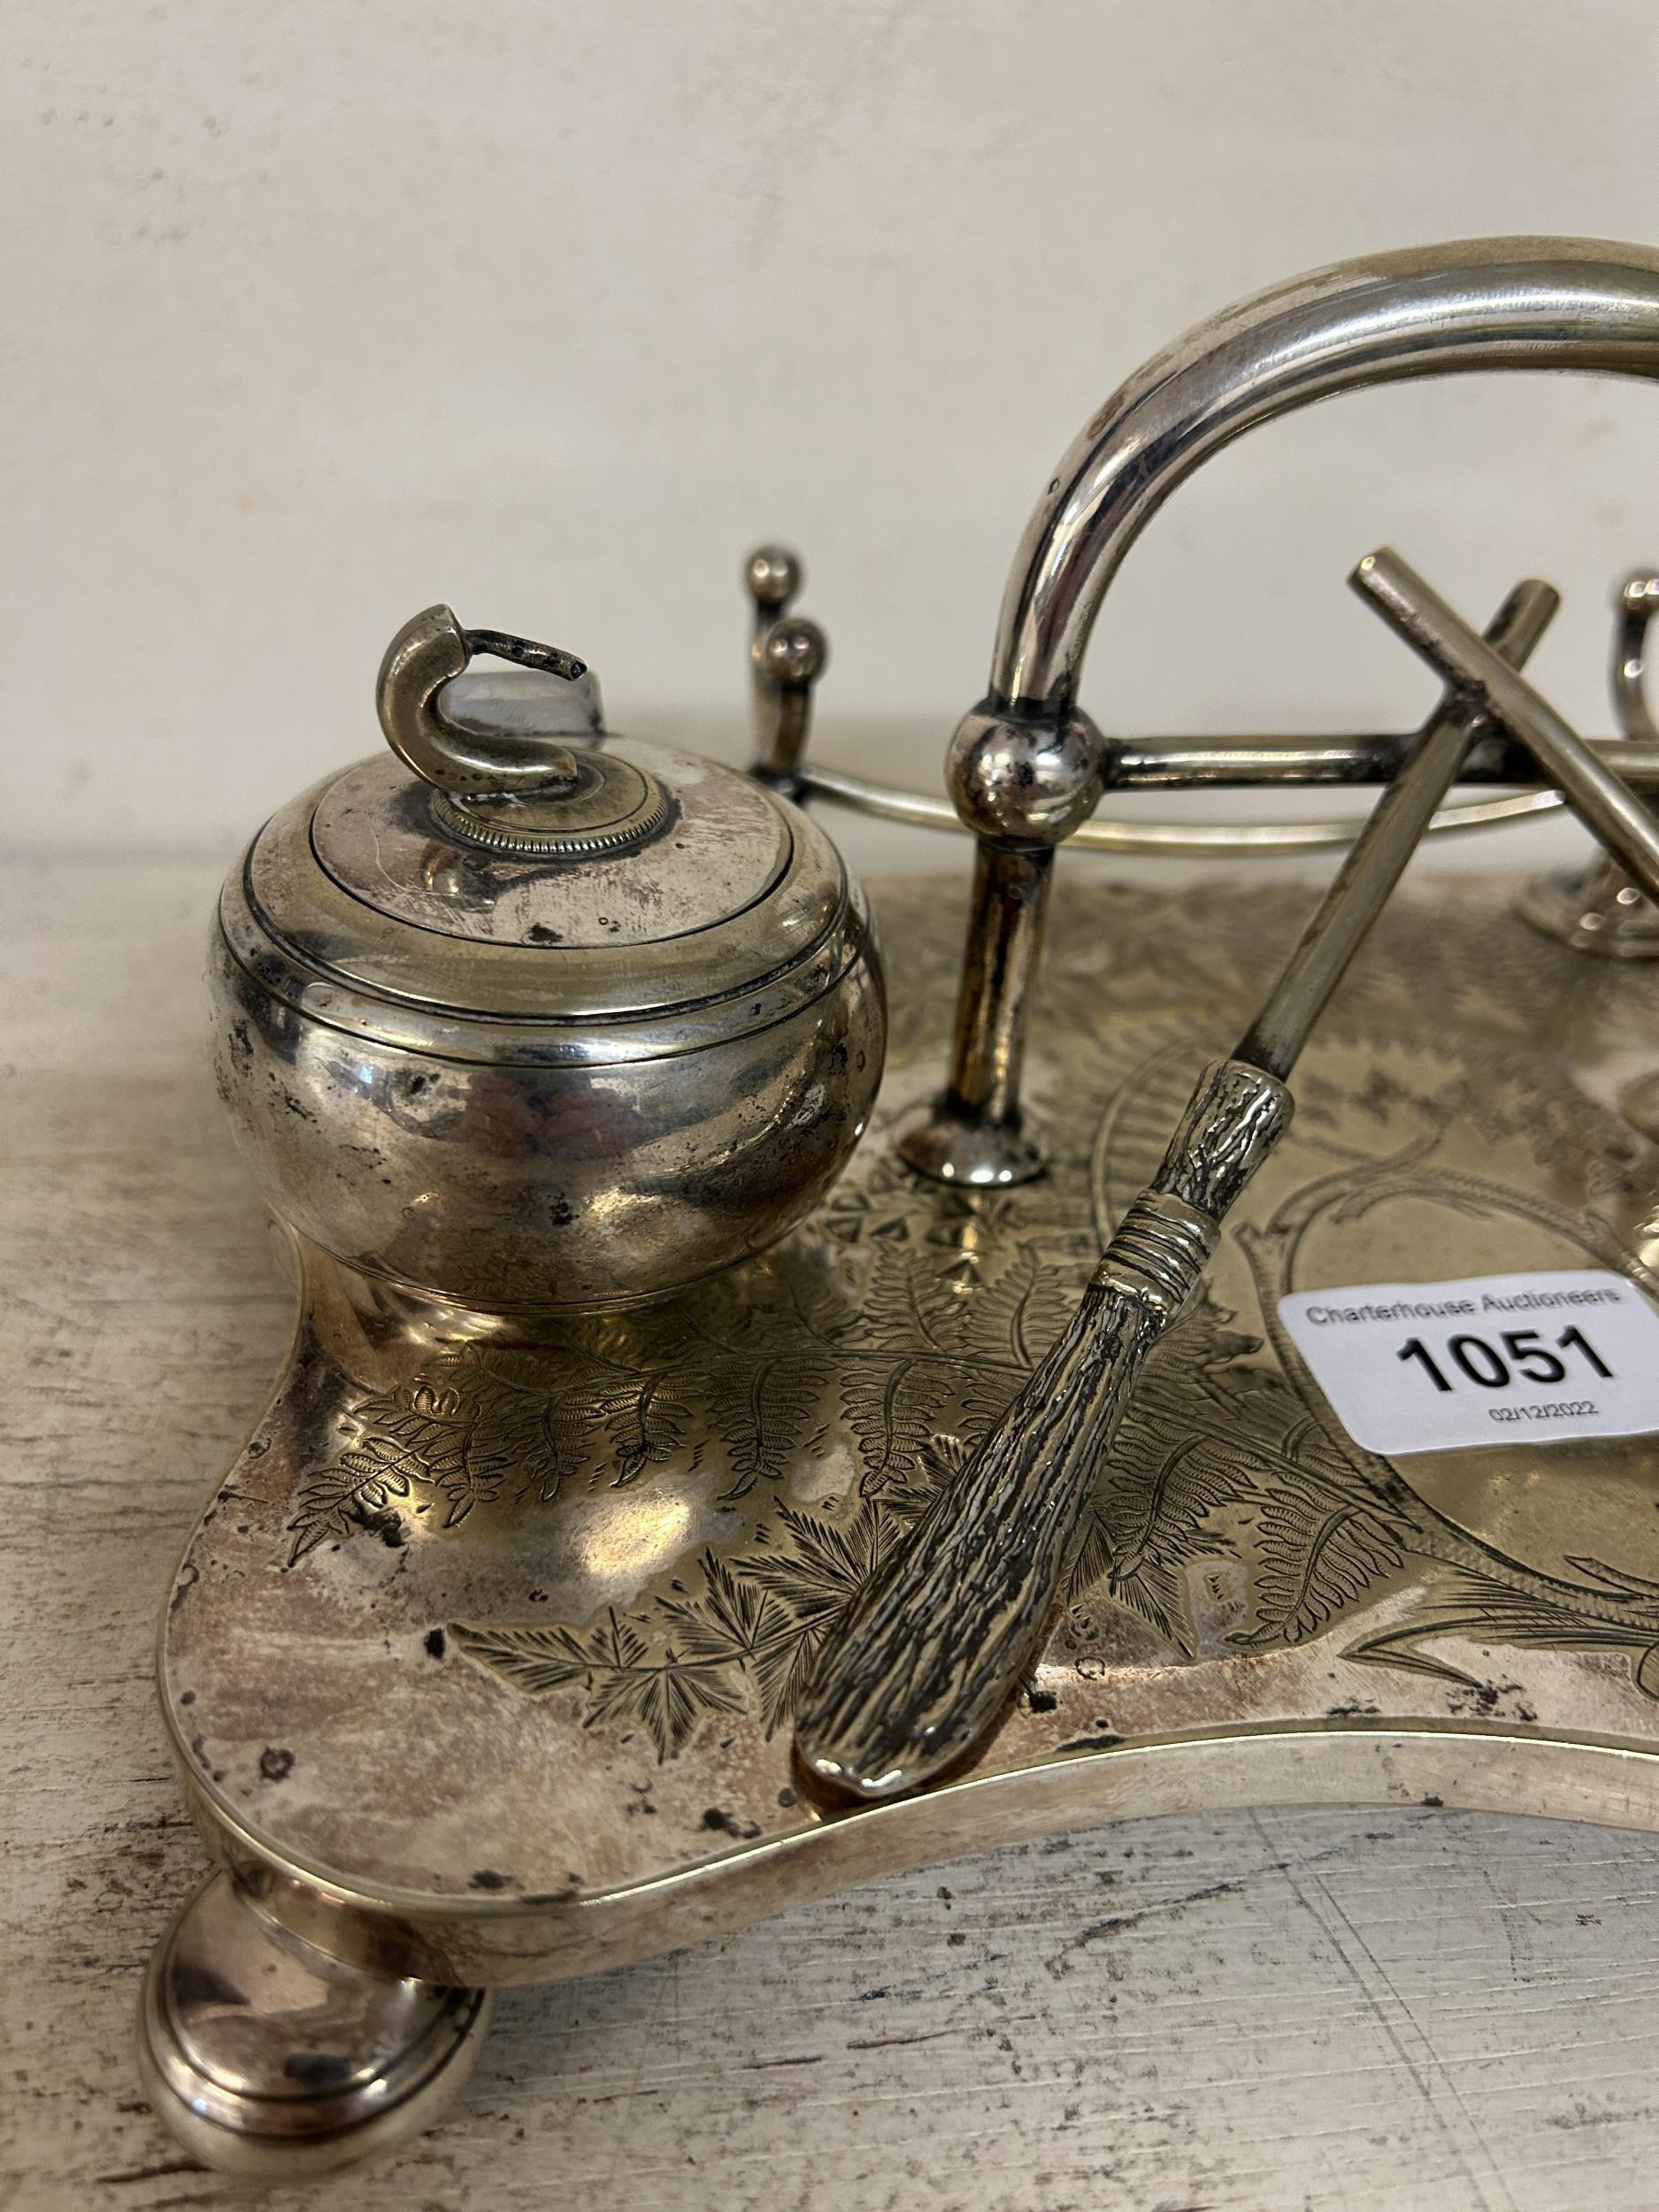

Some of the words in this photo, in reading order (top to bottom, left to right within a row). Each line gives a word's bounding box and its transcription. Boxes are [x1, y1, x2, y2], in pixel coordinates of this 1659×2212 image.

[1305, 1299, 1476, 1325] Charterhouse
[1481, 1287, 1623, 1313] Auctioneers
[1395, 1324, 1615, 1393] 1051
[1488, 1400, 1600, 1422] 02/12/2022
